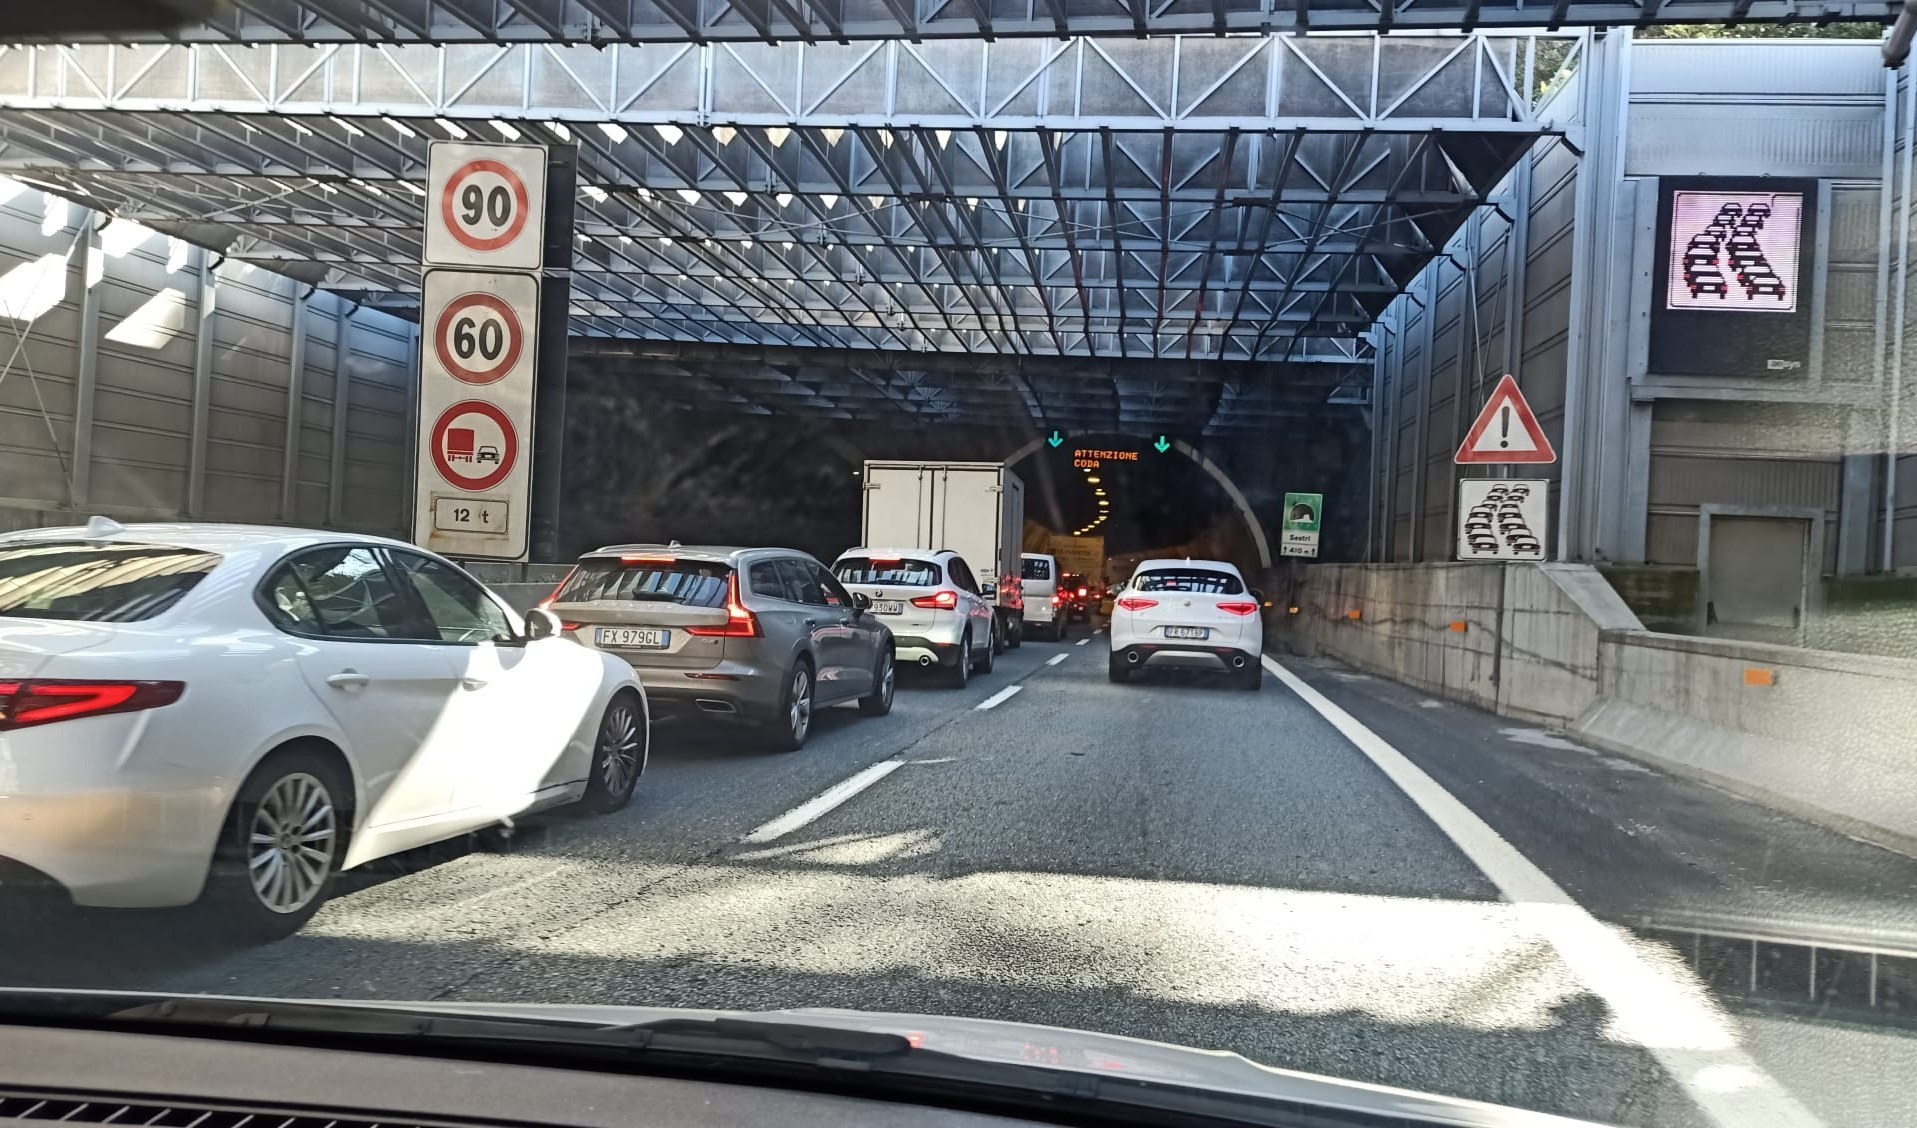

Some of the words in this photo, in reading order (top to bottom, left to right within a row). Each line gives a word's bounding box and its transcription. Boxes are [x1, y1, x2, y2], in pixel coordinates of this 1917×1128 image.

[461, 184, 512, 227] 90
[453, 317, 503, 361] 60
[1074, 449, 1139, 461] ATTENZIONE
[1074, 459, 1100, 468] CODA
[453, 508, 470, 522] 12
[482, 510, 489, 523] t
[603, 630, 618, 644] FX
[622, 630, 660, 644] 979GL
